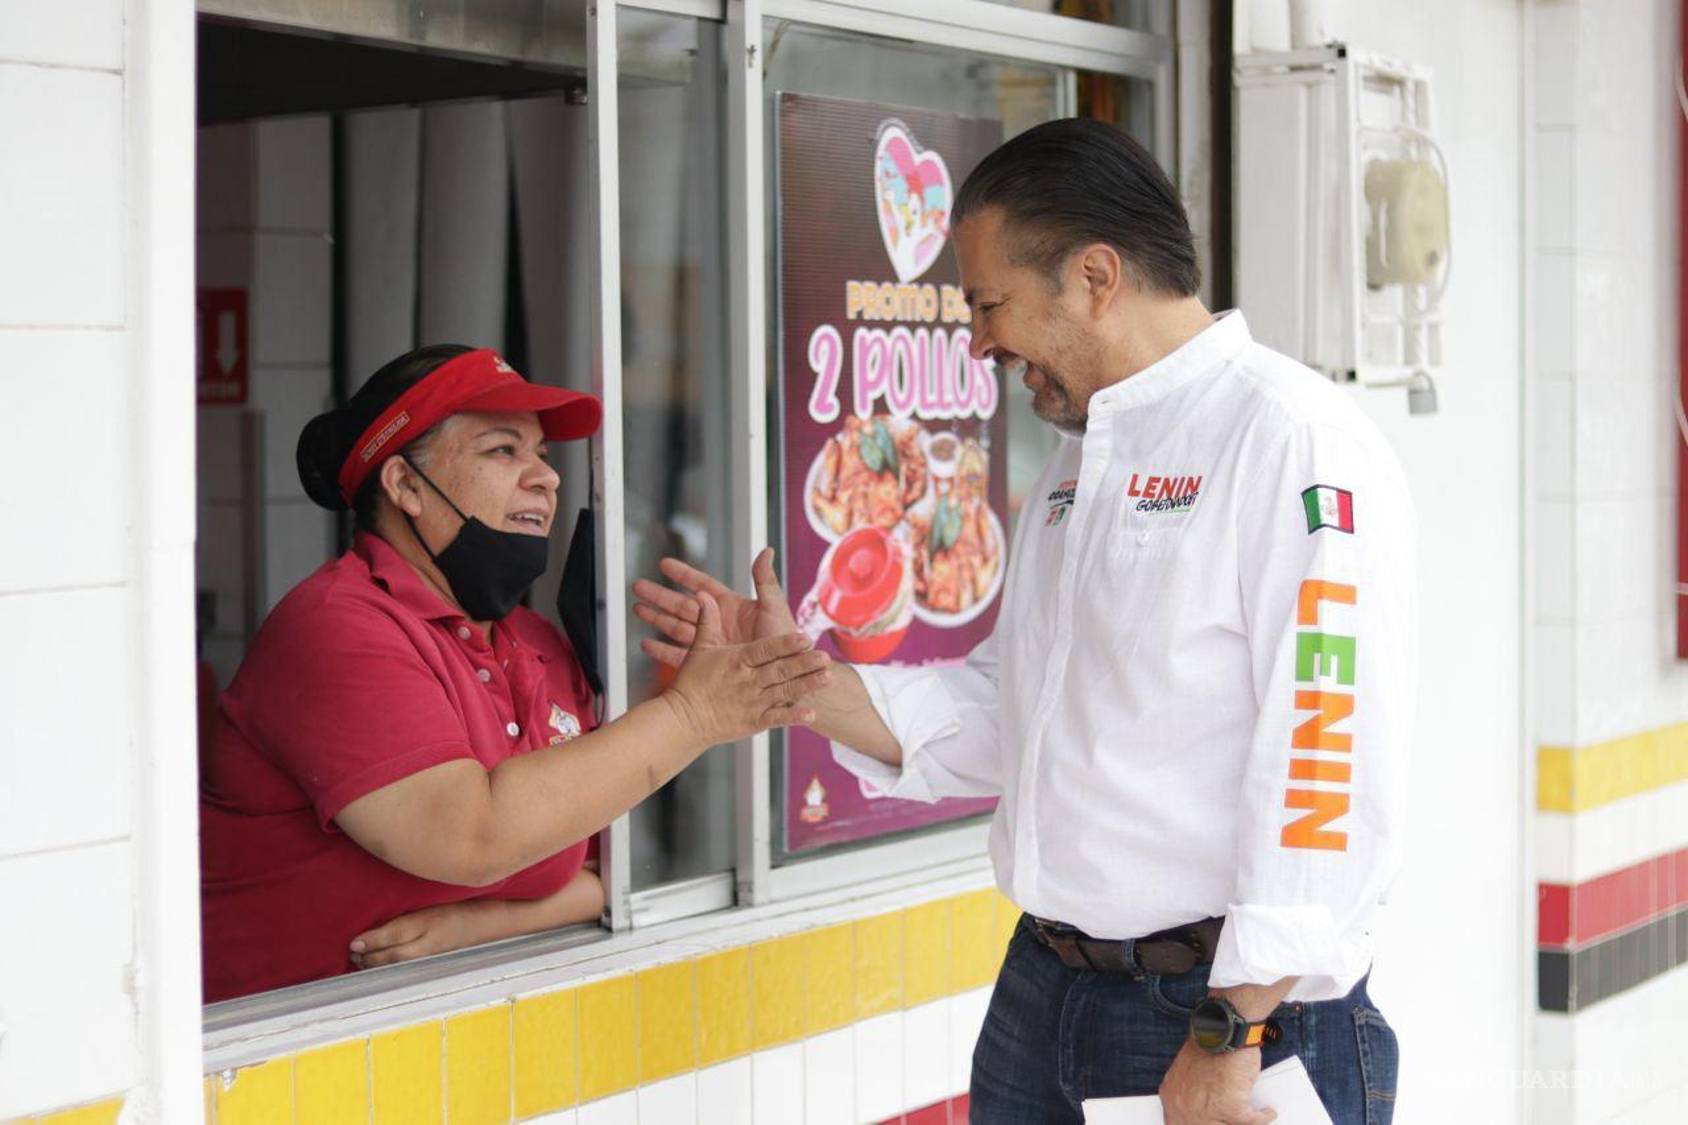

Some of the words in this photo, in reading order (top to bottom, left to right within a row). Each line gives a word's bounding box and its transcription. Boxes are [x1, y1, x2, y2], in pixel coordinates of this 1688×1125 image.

[846, 281, 938, 322] PROMO
[808, 324, 844, 424] 2
[853, 326, 998, 420] POLLOS
[1127, 473, 1203, 500] LENIN
[1280, 579, 1356, 852] LENIN
